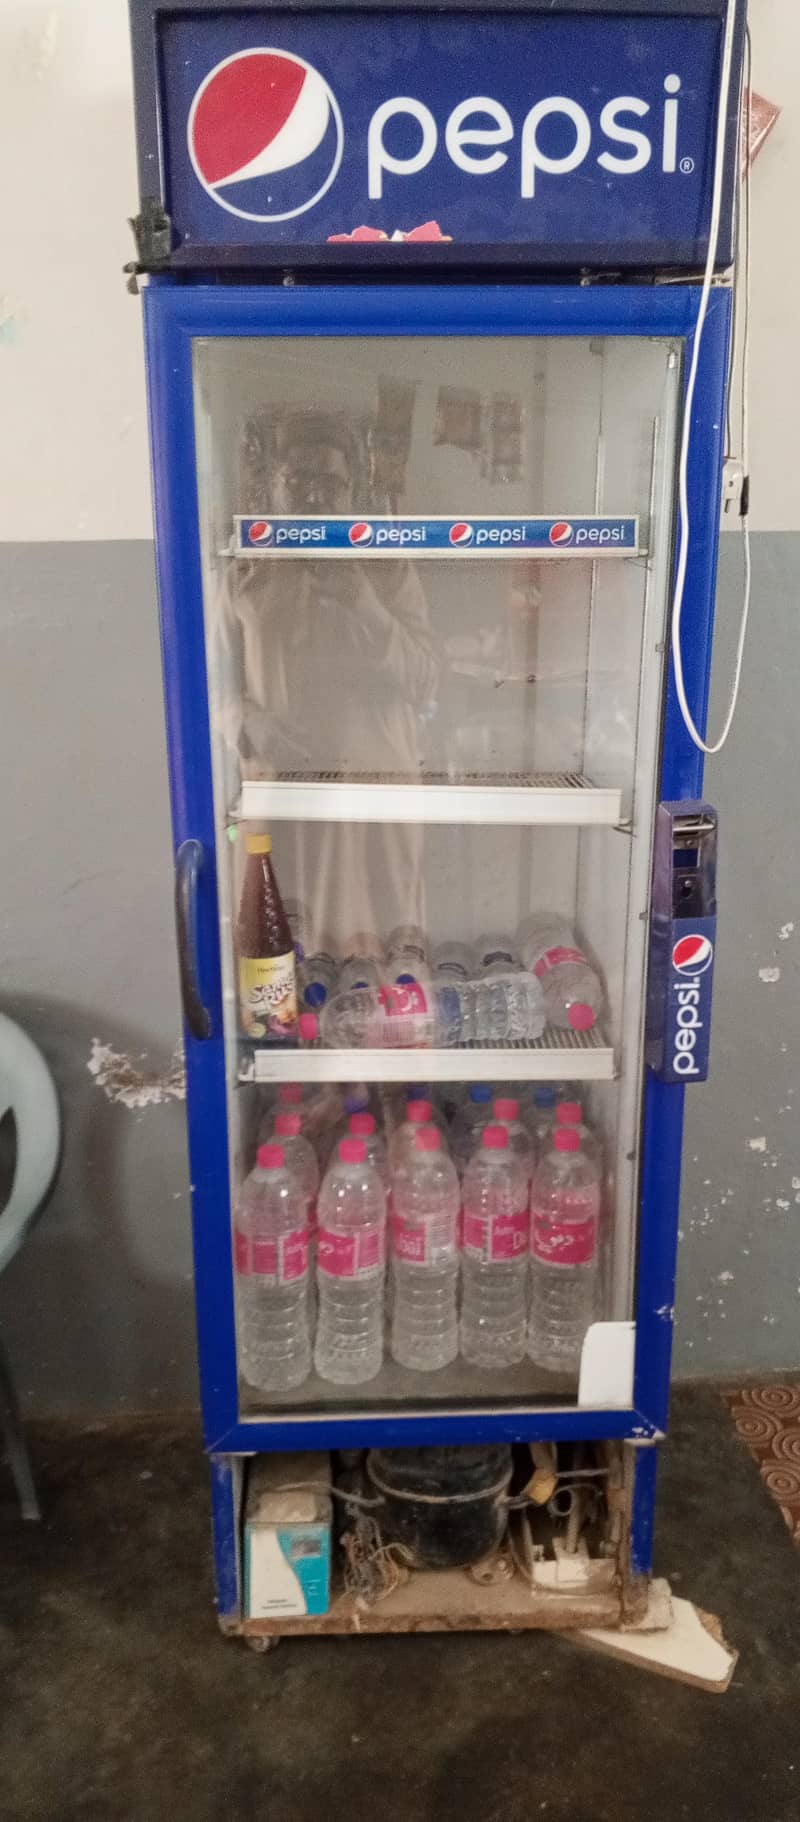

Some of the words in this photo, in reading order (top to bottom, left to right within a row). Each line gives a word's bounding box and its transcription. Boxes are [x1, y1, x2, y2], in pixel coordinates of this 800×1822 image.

[276, 525, 326, 544] pepsi
[376, 526, 426, 545] pepsi
[476, 526, 526, 545] pepsi
[576, 525, 625, 544] pepsi
